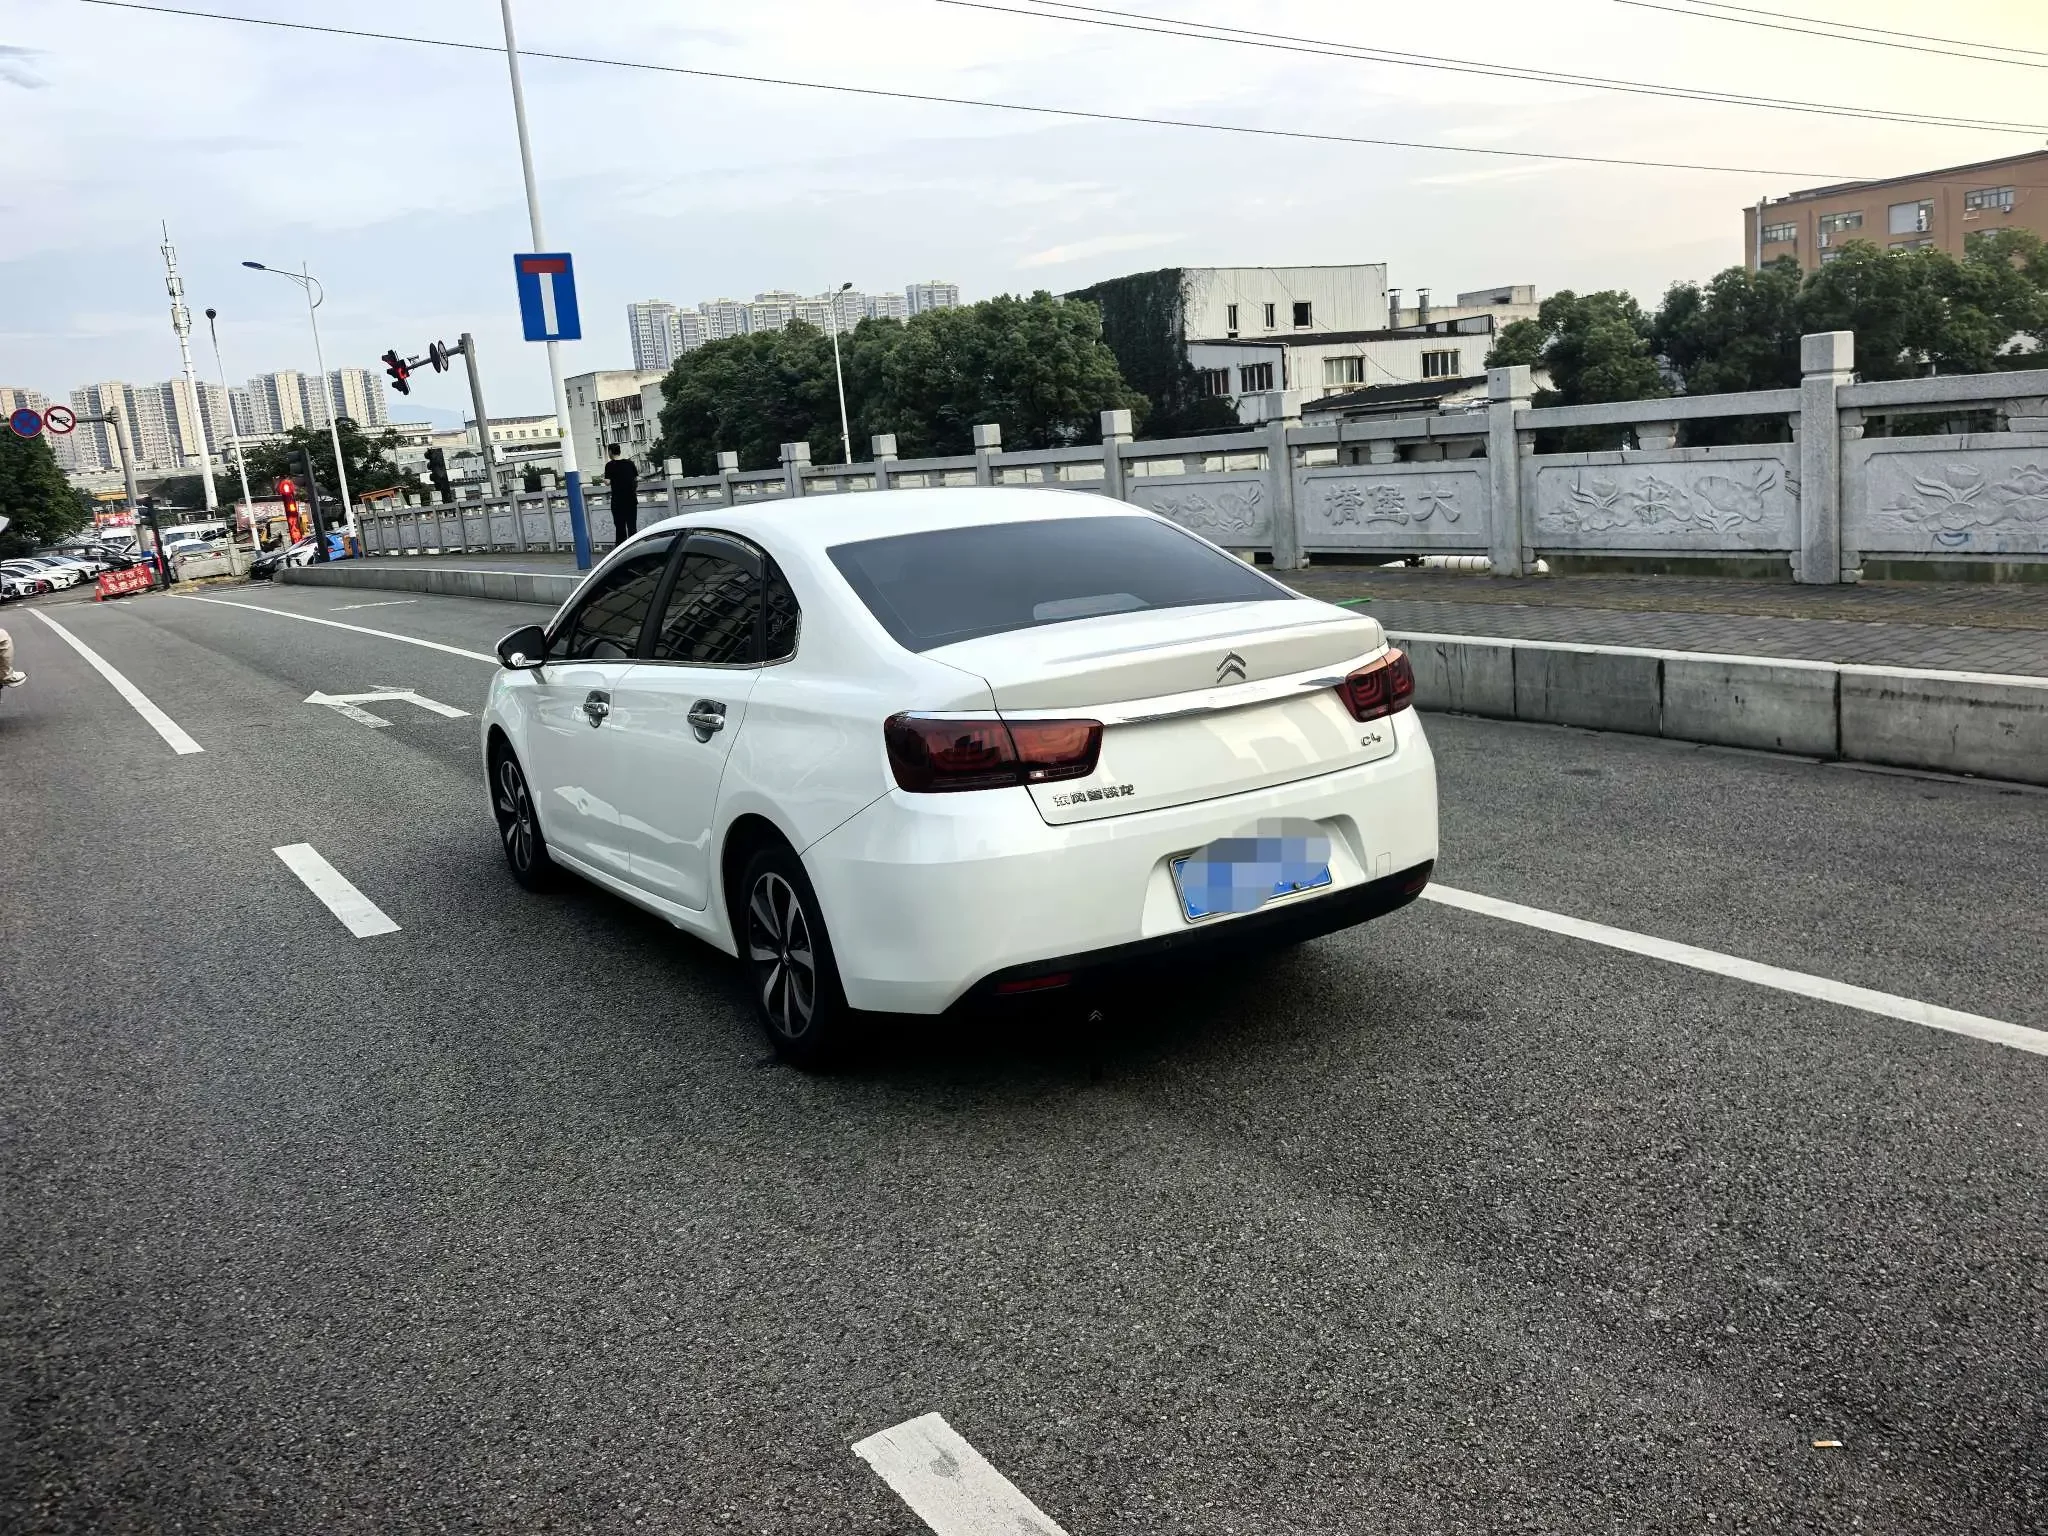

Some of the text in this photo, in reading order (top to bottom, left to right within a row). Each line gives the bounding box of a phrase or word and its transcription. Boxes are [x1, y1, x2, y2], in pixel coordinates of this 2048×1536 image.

[108, 576, 149, 593] 免费评估
[1361, 732, 1382, 747] C4
[1053, 783, 1136, 807] 东风雪铁龙
